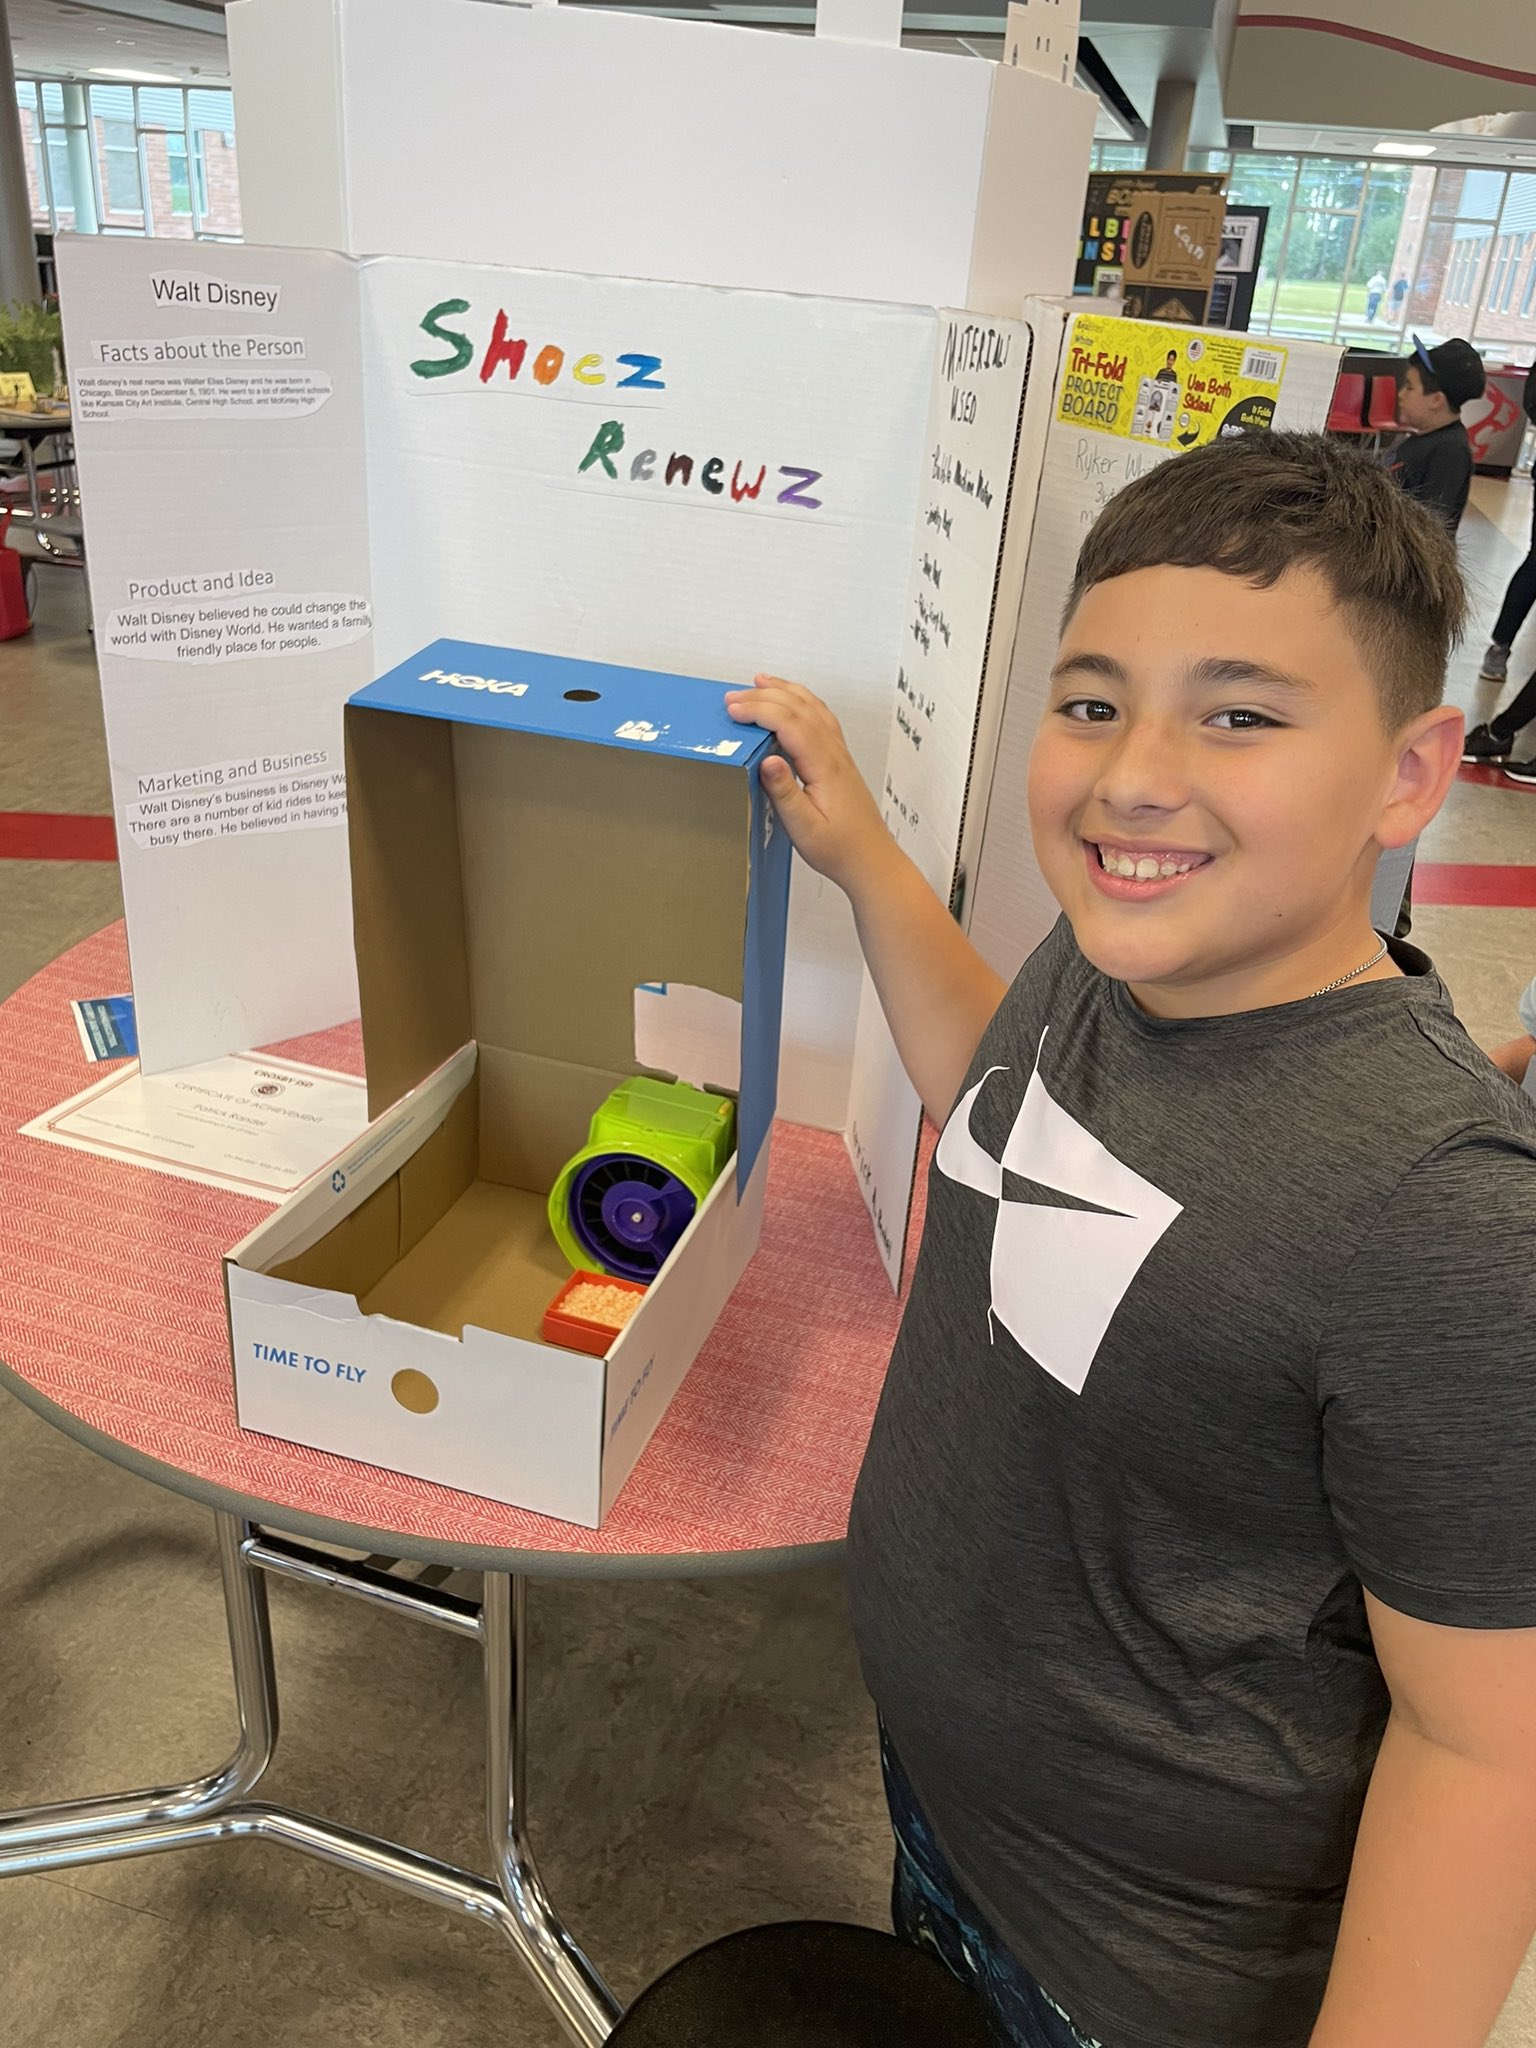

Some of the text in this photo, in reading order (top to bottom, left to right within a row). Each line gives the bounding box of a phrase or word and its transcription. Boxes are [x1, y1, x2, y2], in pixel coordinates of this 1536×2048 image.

[152, 278, 278, 312] Walt Disney
[100, 339, 304, 362] Facts about the Person
[1072, 347, 1128, 382] Tri-Fold
[78, 378, 95, 386] Walt
[225, 378, 249, 387] Disney
[151, 387, 188, 396] December
[1066, 375, 1124, 402] PROJECT
[1207, 378, 1232, 398] Both
[82, 410, 110, 418] School.
[96, 399, 124, 407] Kansas
[125, 399, 140, 408] City
[185, 398, 211, 406] Central
[212, 398, 229, 407] High
[256, 397, 269, 405] and
[301, 396, 316, 406] High
[950, 386, 977, 425] USED
[1062, 393, 1118, 423] BOARD
[1076, 438, 1119, 480] Ryker
[129, 570, 274, 600] Product and Idea
[117, 599, 366, 627] Walt Disney believed he could change the
[111, 632, 147, 646] world
[150, 629, 176, 642] with
[180, 625, 223, 643] Disney
[226, 624, 265, 637] World.
[268, 621, 284, 633] He
[288, 618, 329, 632] wanted
[332, 619, 339, 628] a
[177, 636, 321, 658] friendly place for people.
[418, 669, 530, 697] HOKA
[138, 751, 328, 795] Marketing and Business
[140, 801, 168, 816] Walt
[172, 794, 222, 811] Disney's
[225, 786, 276, 802] business
[279, 782, 289, 794] is
[292, 778, 328, 793] Disney
[129, 818, 167, 834] There
[170, 816, 190, 827] are
[194, 814, 201, 823] a
[204, 807, 249, 822] number
[253, 803, 264, 813] of
[266, 798, 282, 810] kid
[286, 795, 313, 809] rides
[315, 793, 326, 802] to
[150, 832, 180, 847] busy
[183, 826, 217, 840] there.
[221, 823, 237, 834] He
[240, 816, 288, 831] believed
[291, 812, 300, 822] in
[303, 806, 339, 821] having
[175, 1082, 324, 1124] CERTIFICATE OF ACHIEVEMENT
[253, 1343, 367, 1383] TIME TO FLY
